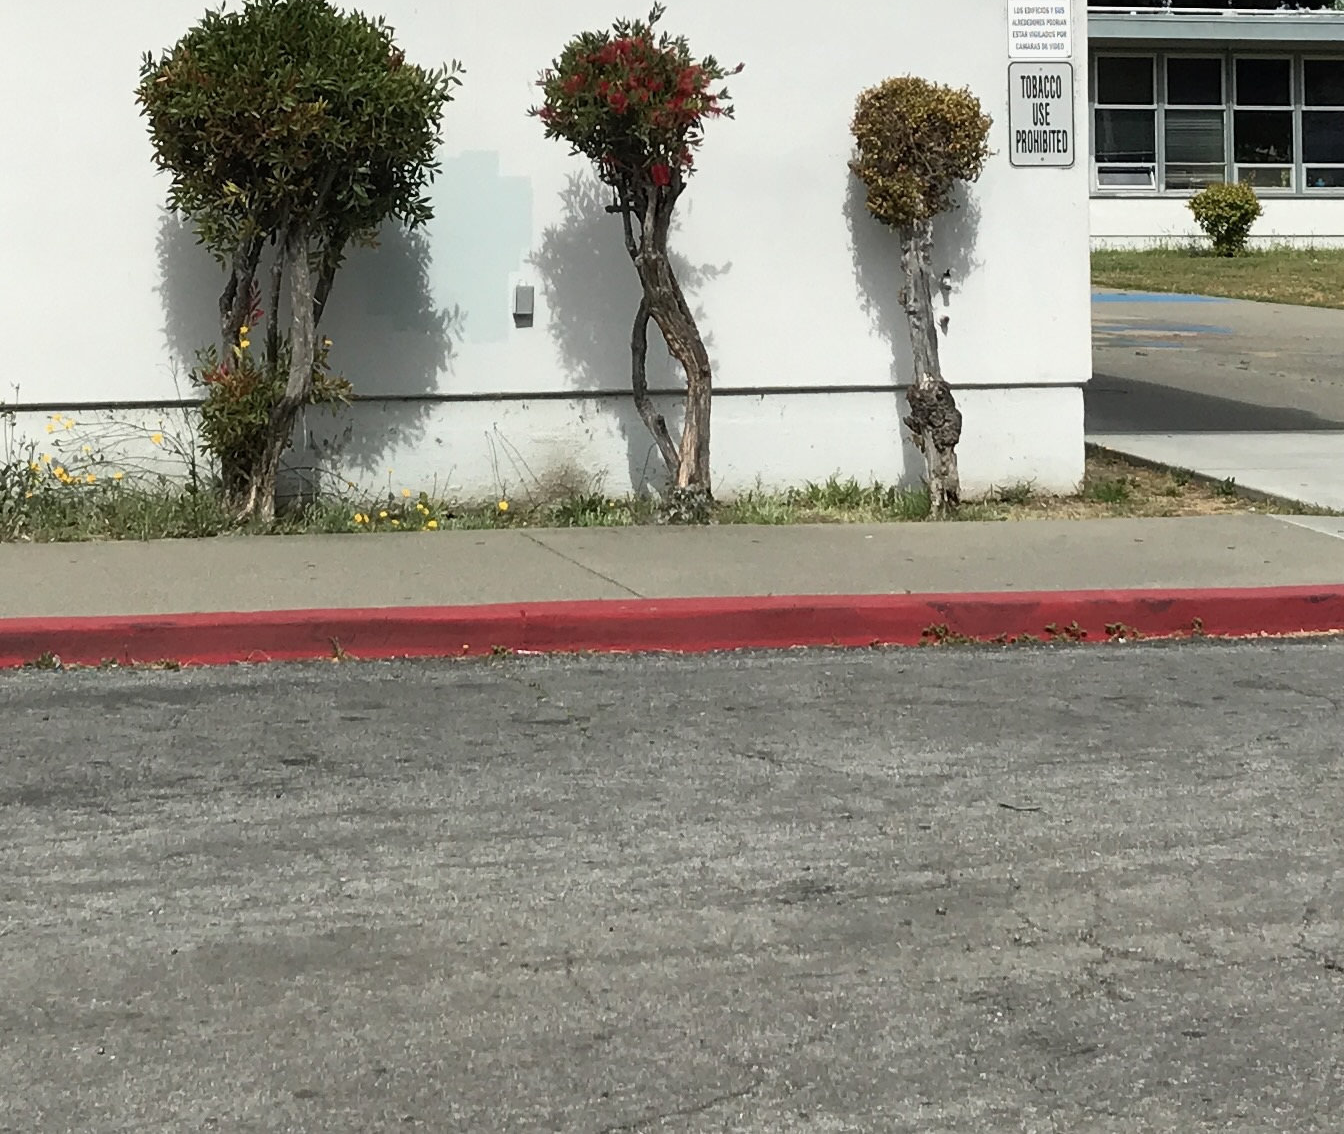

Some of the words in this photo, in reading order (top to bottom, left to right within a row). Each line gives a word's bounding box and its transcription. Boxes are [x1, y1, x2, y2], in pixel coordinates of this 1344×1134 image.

[1020, 75, 1061, 98] TOBACCO
[1033, 102, 1050, 126] USE
[1016, 130, 1067, 153] PROHIBITED
